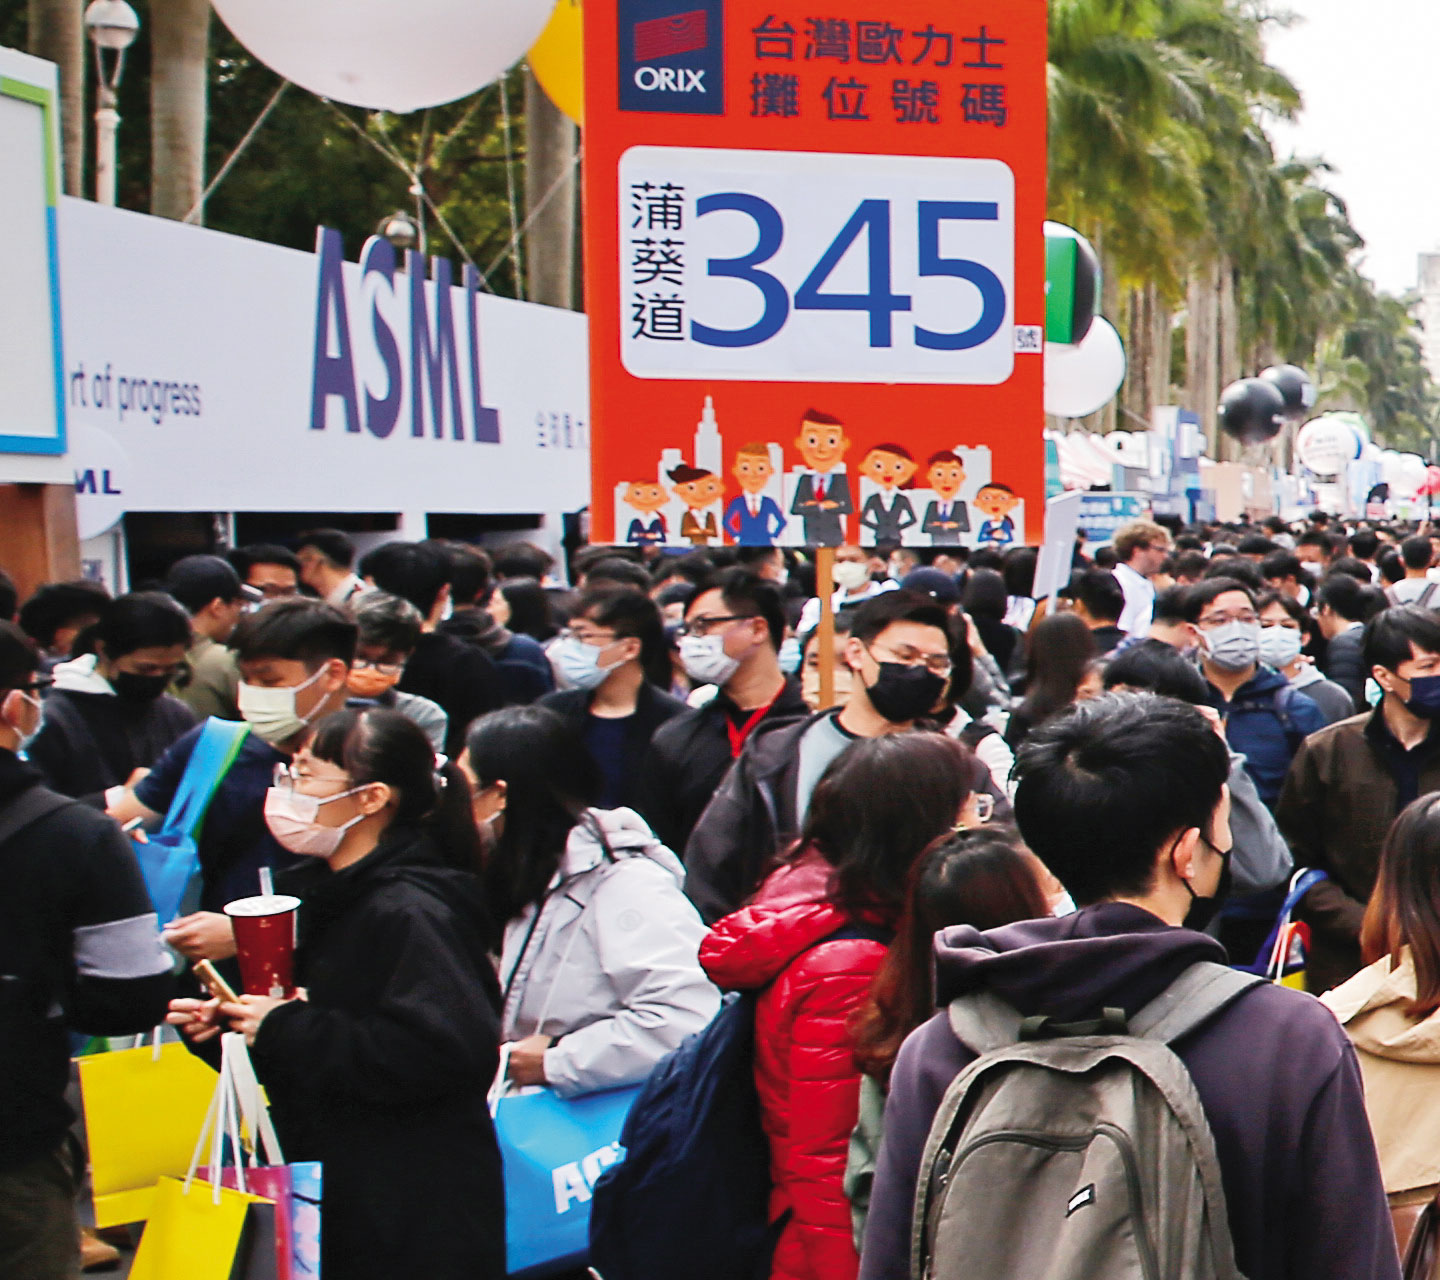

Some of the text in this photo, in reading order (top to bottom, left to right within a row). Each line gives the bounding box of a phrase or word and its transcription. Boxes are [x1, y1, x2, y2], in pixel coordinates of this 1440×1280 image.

[751, 14, 1006, 71] 台灣歐力士
[634, 67, 707, 93] ORIX
[750, 71, 1008, 128] 攤位號碼
[630, 181, 687, 343] 蒲葵道
[690, 191, 1007, 351] 345
[309, 225, 502, 445] ASML
[92, 363, 112, 408] of
[118, 376, 201, 424] progress
